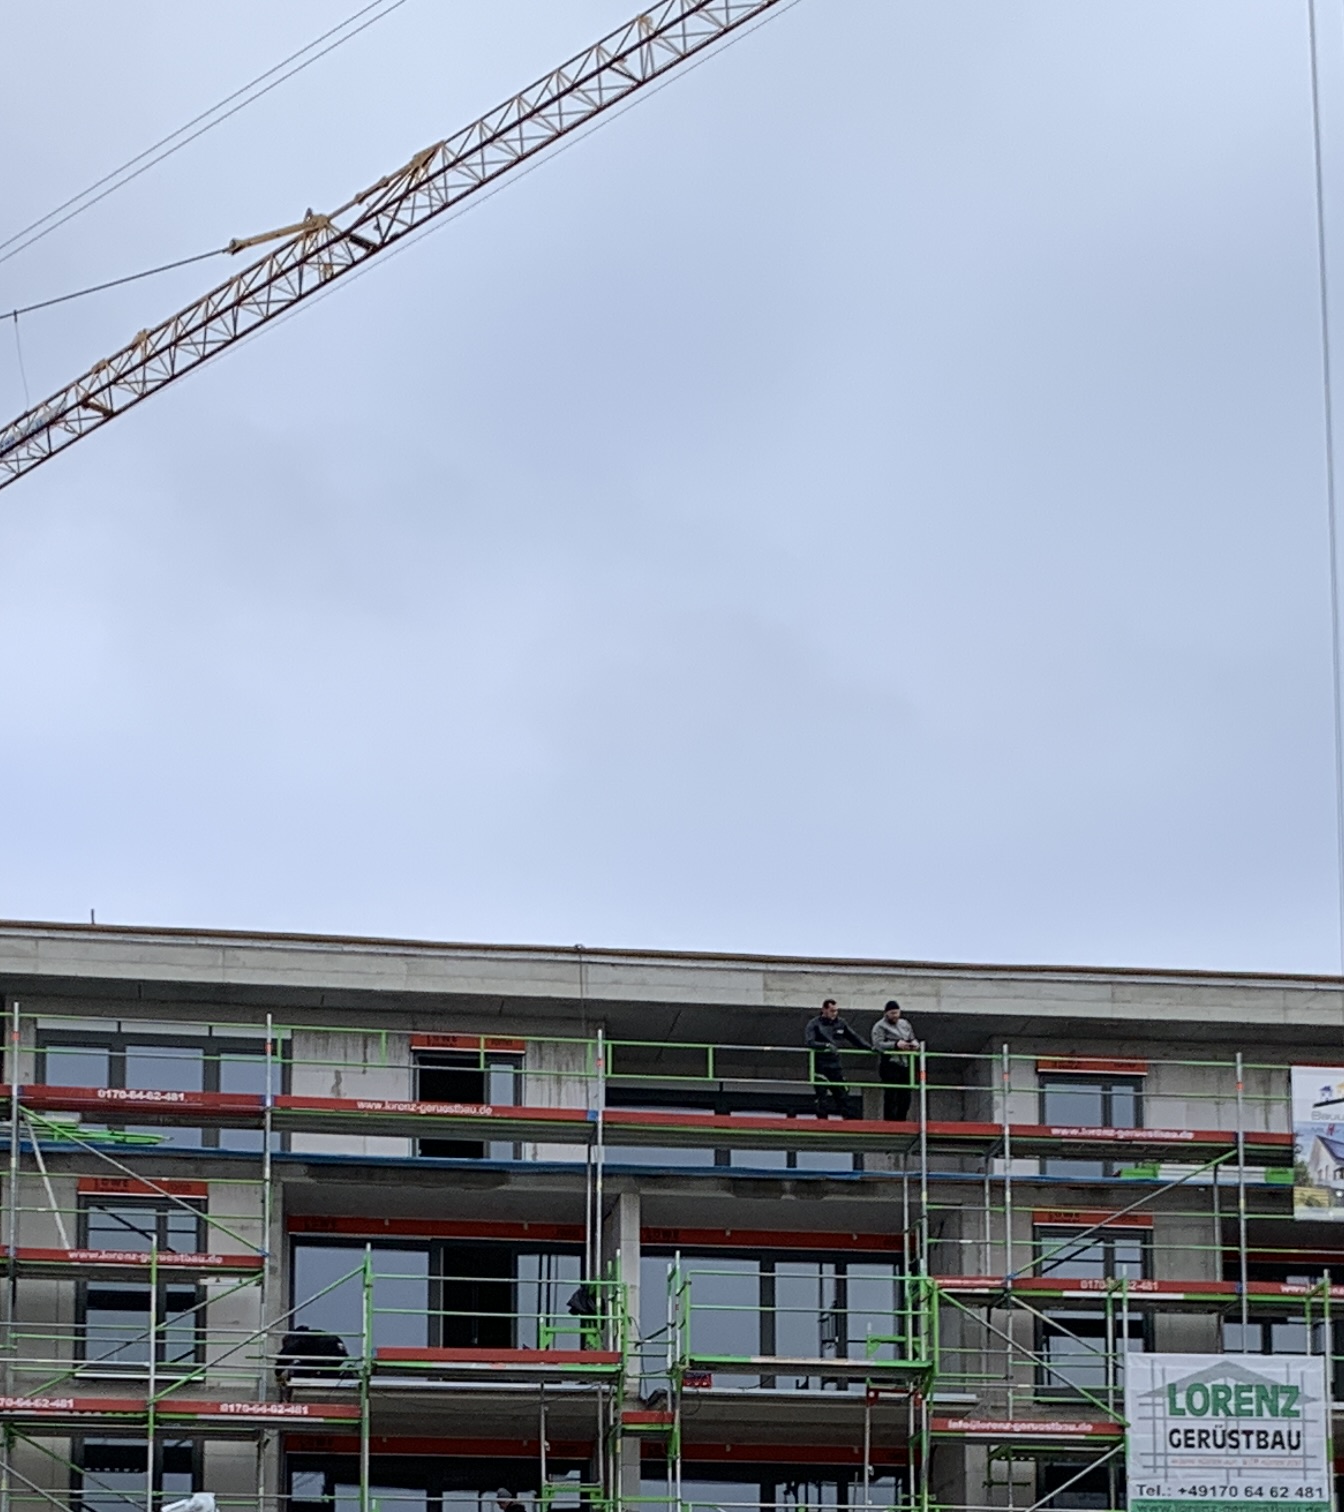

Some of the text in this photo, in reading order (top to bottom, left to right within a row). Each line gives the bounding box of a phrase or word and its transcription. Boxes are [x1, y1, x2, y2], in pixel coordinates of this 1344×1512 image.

[1167, 1383, 1301, 1418] LORENZ
[1169, 1424, 1301, 1451] GERÜSTBAU
[1136, 1484, 1324, 1498] Tel.: +49170 64 62 481
